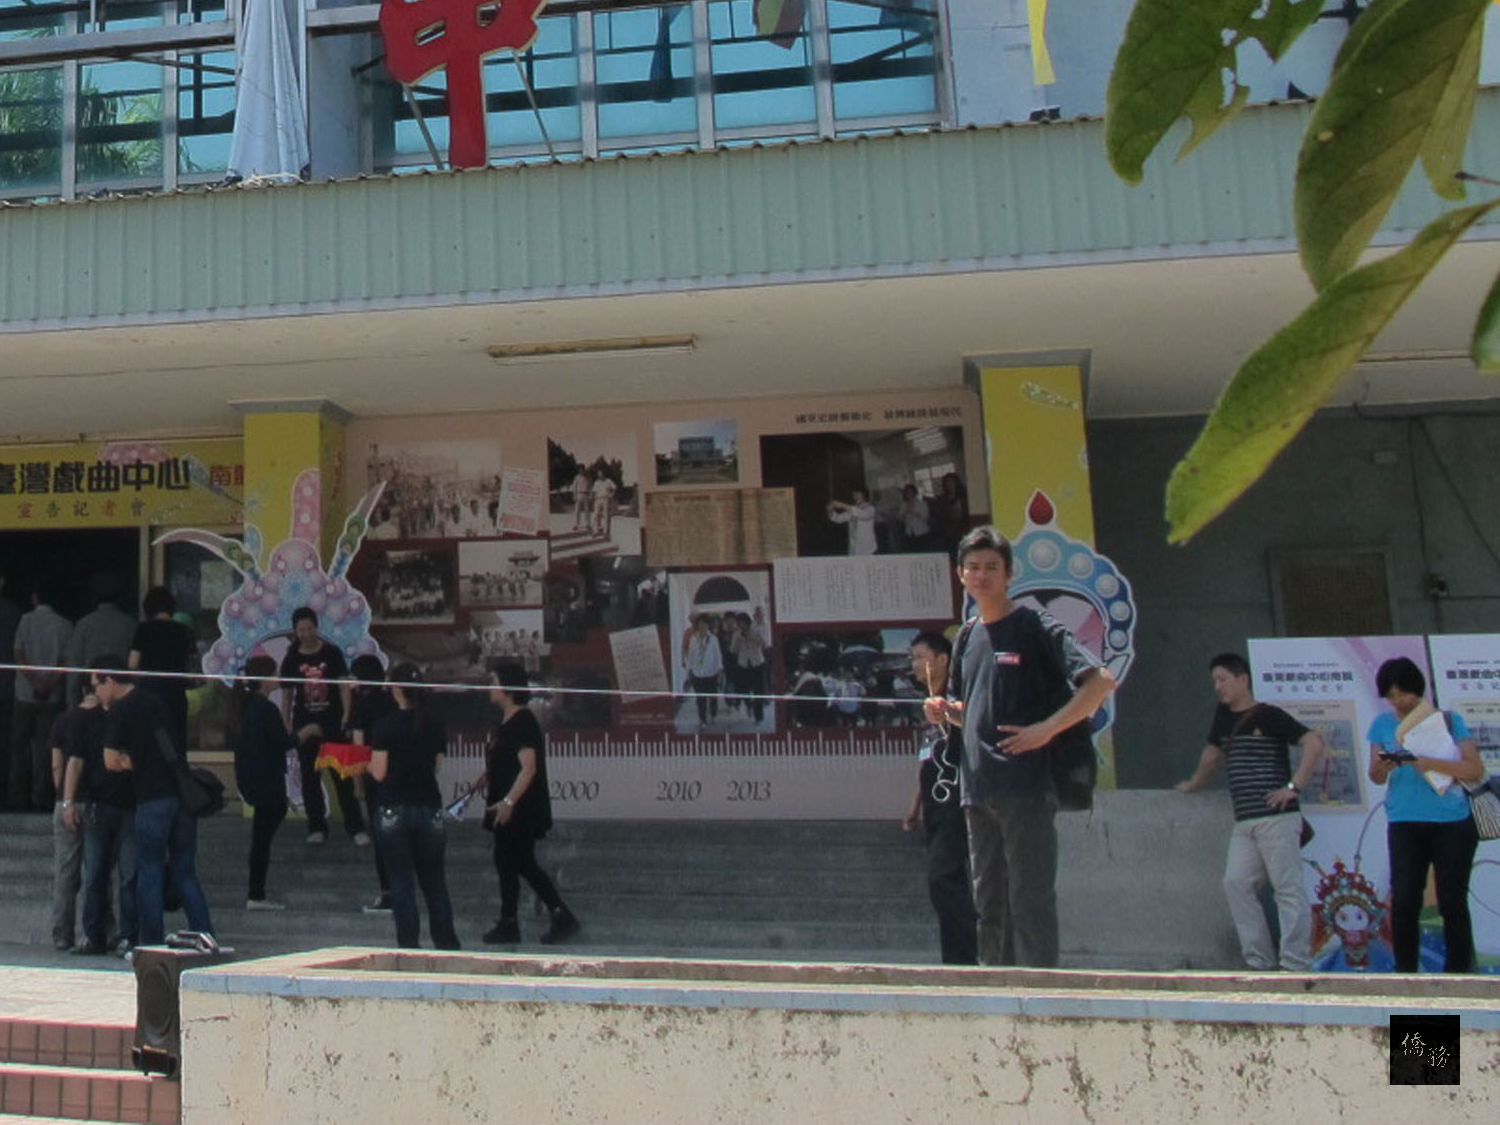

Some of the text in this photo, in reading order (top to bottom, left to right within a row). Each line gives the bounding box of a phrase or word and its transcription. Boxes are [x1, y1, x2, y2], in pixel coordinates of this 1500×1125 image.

[550, 779, 599, 801] 2000
[656, 779, 702, 801] 2010
[726, 779, 772, 801] 2013
